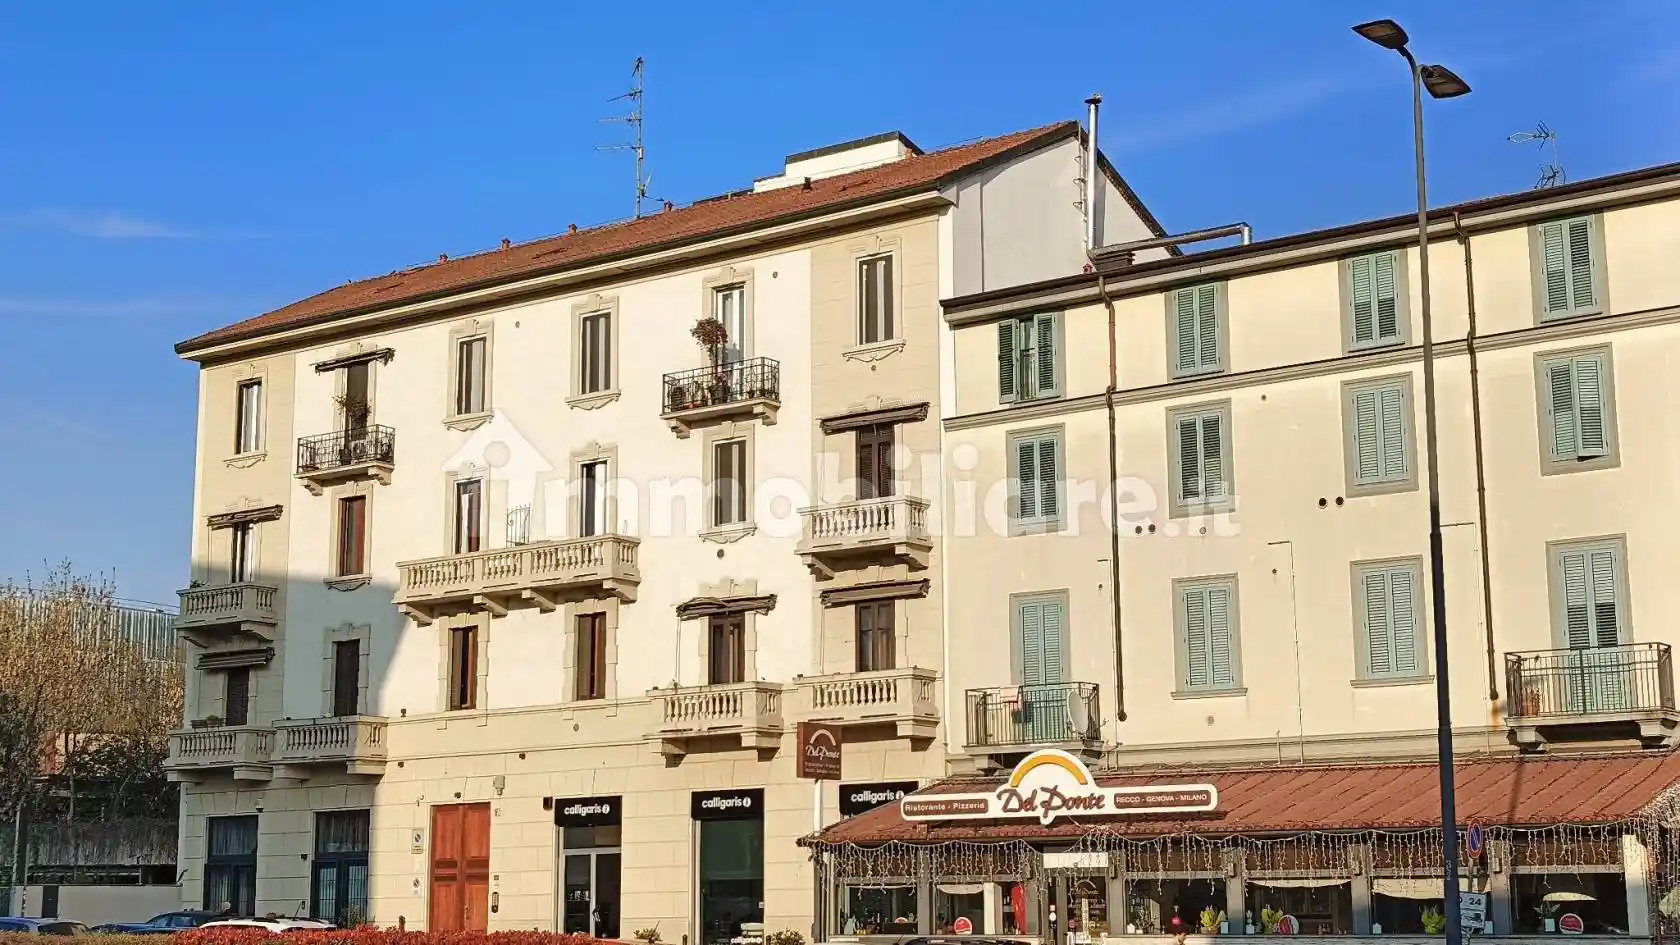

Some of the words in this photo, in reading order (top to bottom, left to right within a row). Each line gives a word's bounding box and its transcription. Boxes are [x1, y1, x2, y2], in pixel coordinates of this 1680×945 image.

[701, 796, 742, 810] calligaris
[851, 789, 894, 804] calligaris
[996, 788, 1038, 813] Del
[1039, 785, 1106, 819] Ponte
[1116, 796, 1141, 804] RECCO
[1146, 795, 1175, 803] GENOVA
[1180, 793, 1208, 801] MILANO
[564, 803, 601, 816] calligaris
[904, 803, 946, 812] Ristorante
[952, 801, 985, 811] Pizzeria
[1469, 897, 1482, 906] 24
